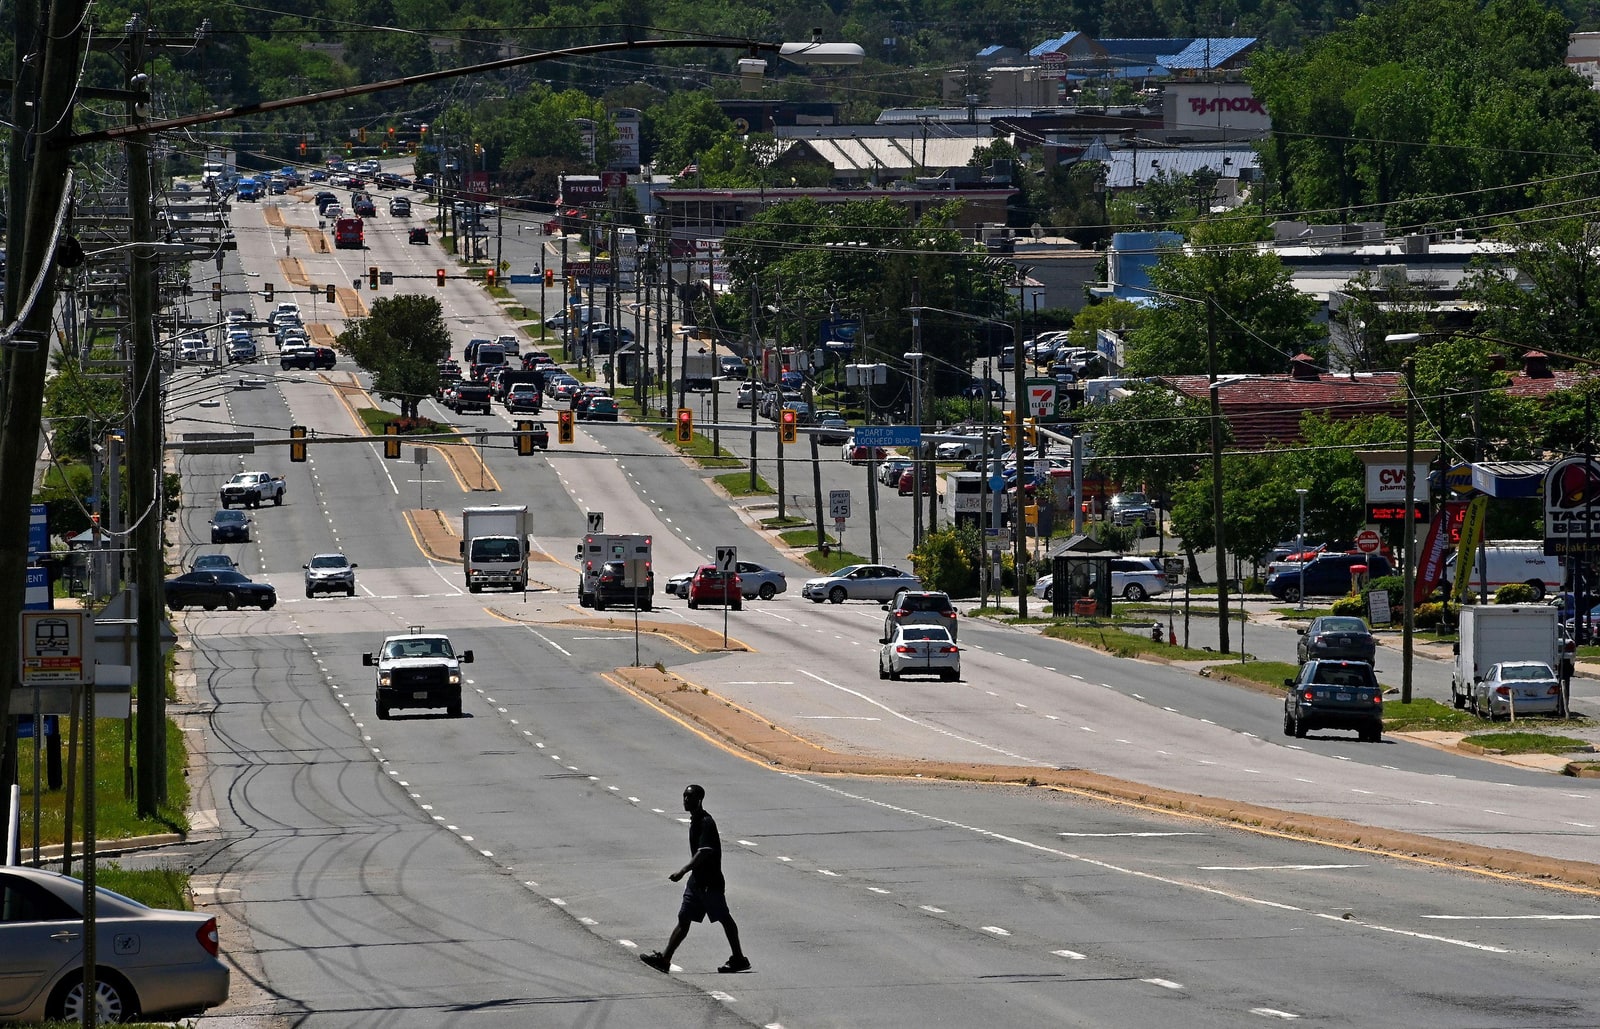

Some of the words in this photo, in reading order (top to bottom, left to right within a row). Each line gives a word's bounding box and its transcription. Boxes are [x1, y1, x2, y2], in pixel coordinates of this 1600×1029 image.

[833, 506, 848, 514] 45
[1469, 504, 1479, 527] CARE
[1466, 527, 1474, 545] CAR
[1556, 544, 1600, 552] Brakfst
[1423, 562, 1437, 582] NEW
[1457, 548, 1471, 589] COMPLETE
